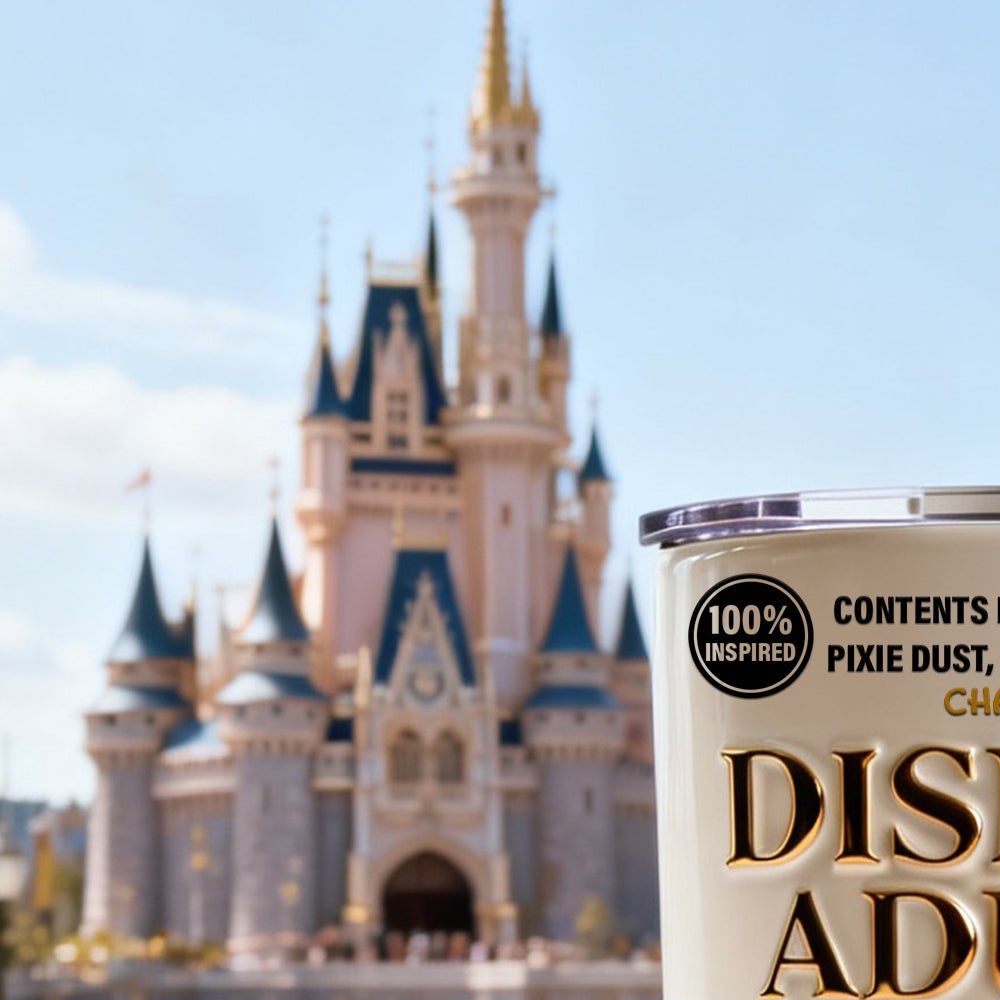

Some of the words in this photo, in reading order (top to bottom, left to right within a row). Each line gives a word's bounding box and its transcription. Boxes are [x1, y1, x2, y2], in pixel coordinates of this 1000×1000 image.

[709, 604, 793, 635] 100%
[834, 596, 989, 625] CONTENTS
[706, 642, 796, 661] INSPIRED
[828, 644, 903, 673] PIXIE
[912, 644, 994, 675] DUST,
